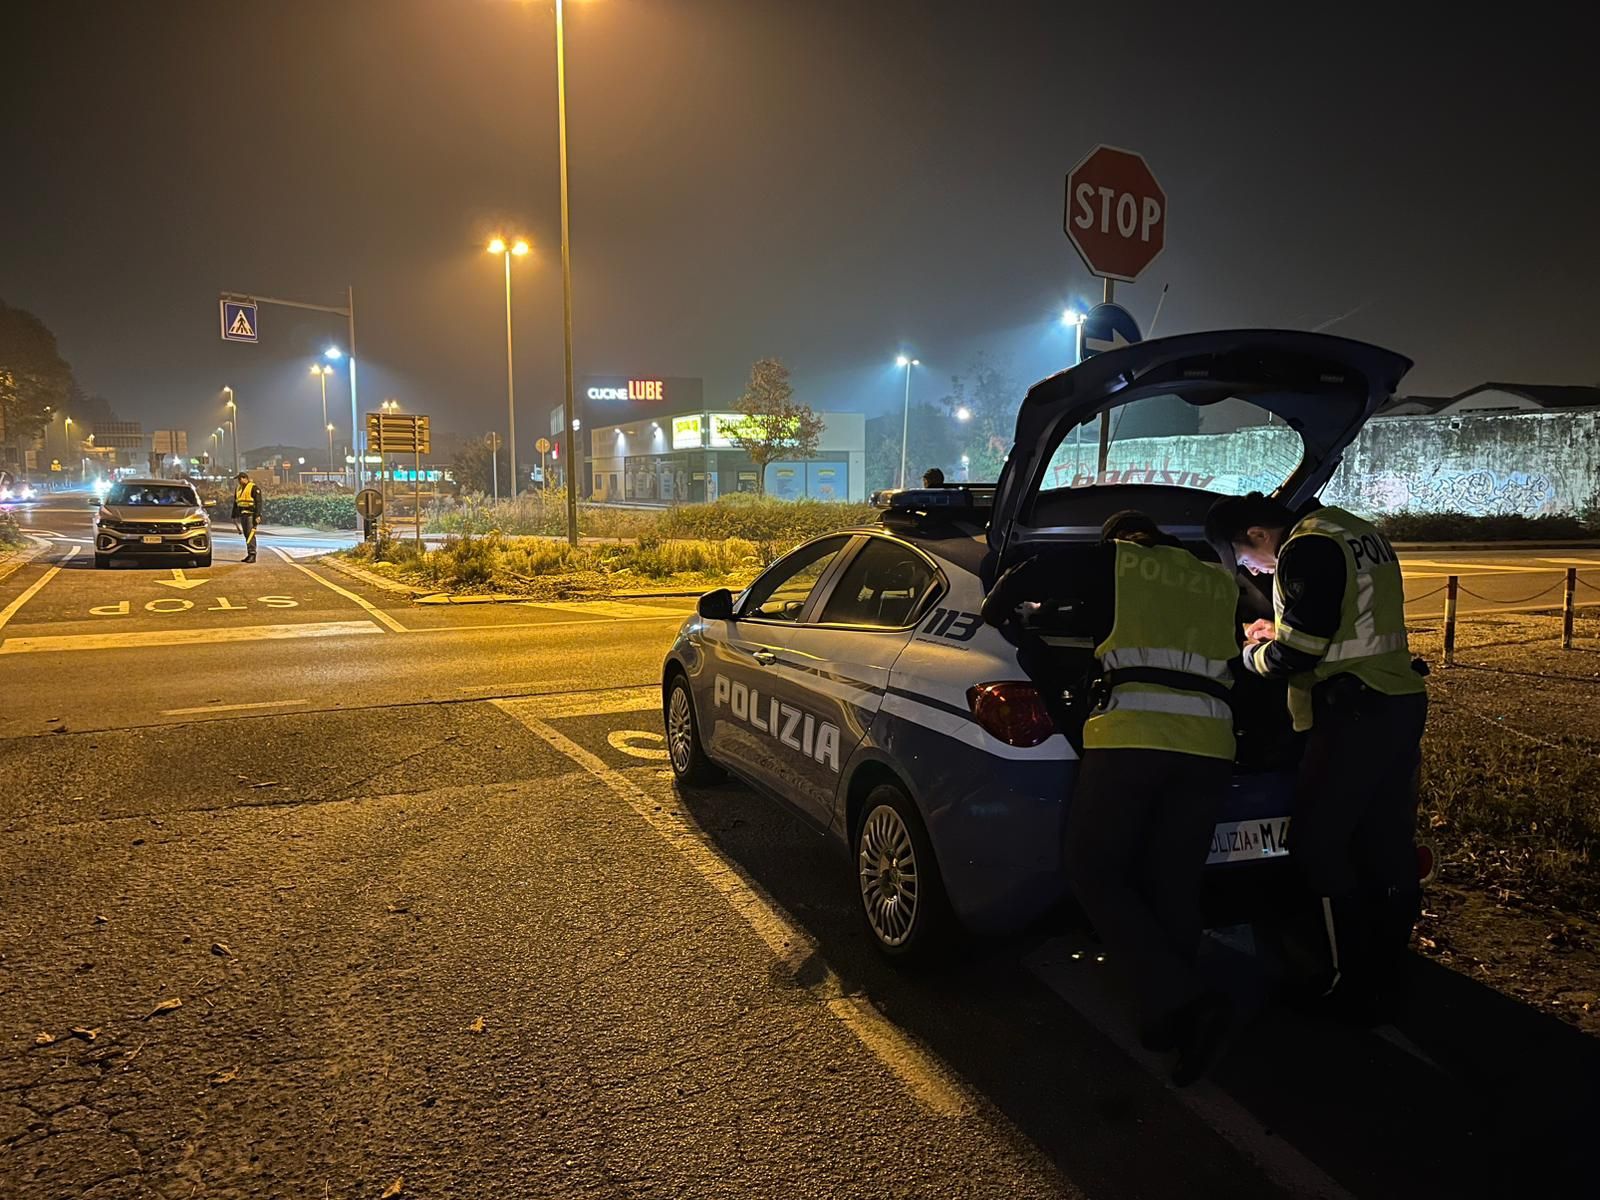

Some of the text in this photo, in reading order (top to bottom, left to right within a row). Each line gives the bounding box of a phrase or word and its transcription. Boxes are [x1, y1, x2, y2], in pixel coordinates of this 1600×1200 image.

[1075, 183, 1161, 242] STOP
[587, 380, 664, 400] CUCINE LUBE
[1118, 551, 1227, 599] POLIZIA
[89, 595, 299, 616] STOP
[922, 608, 985, 642] 113
[714, 673, 840, 774] POLIZIA
